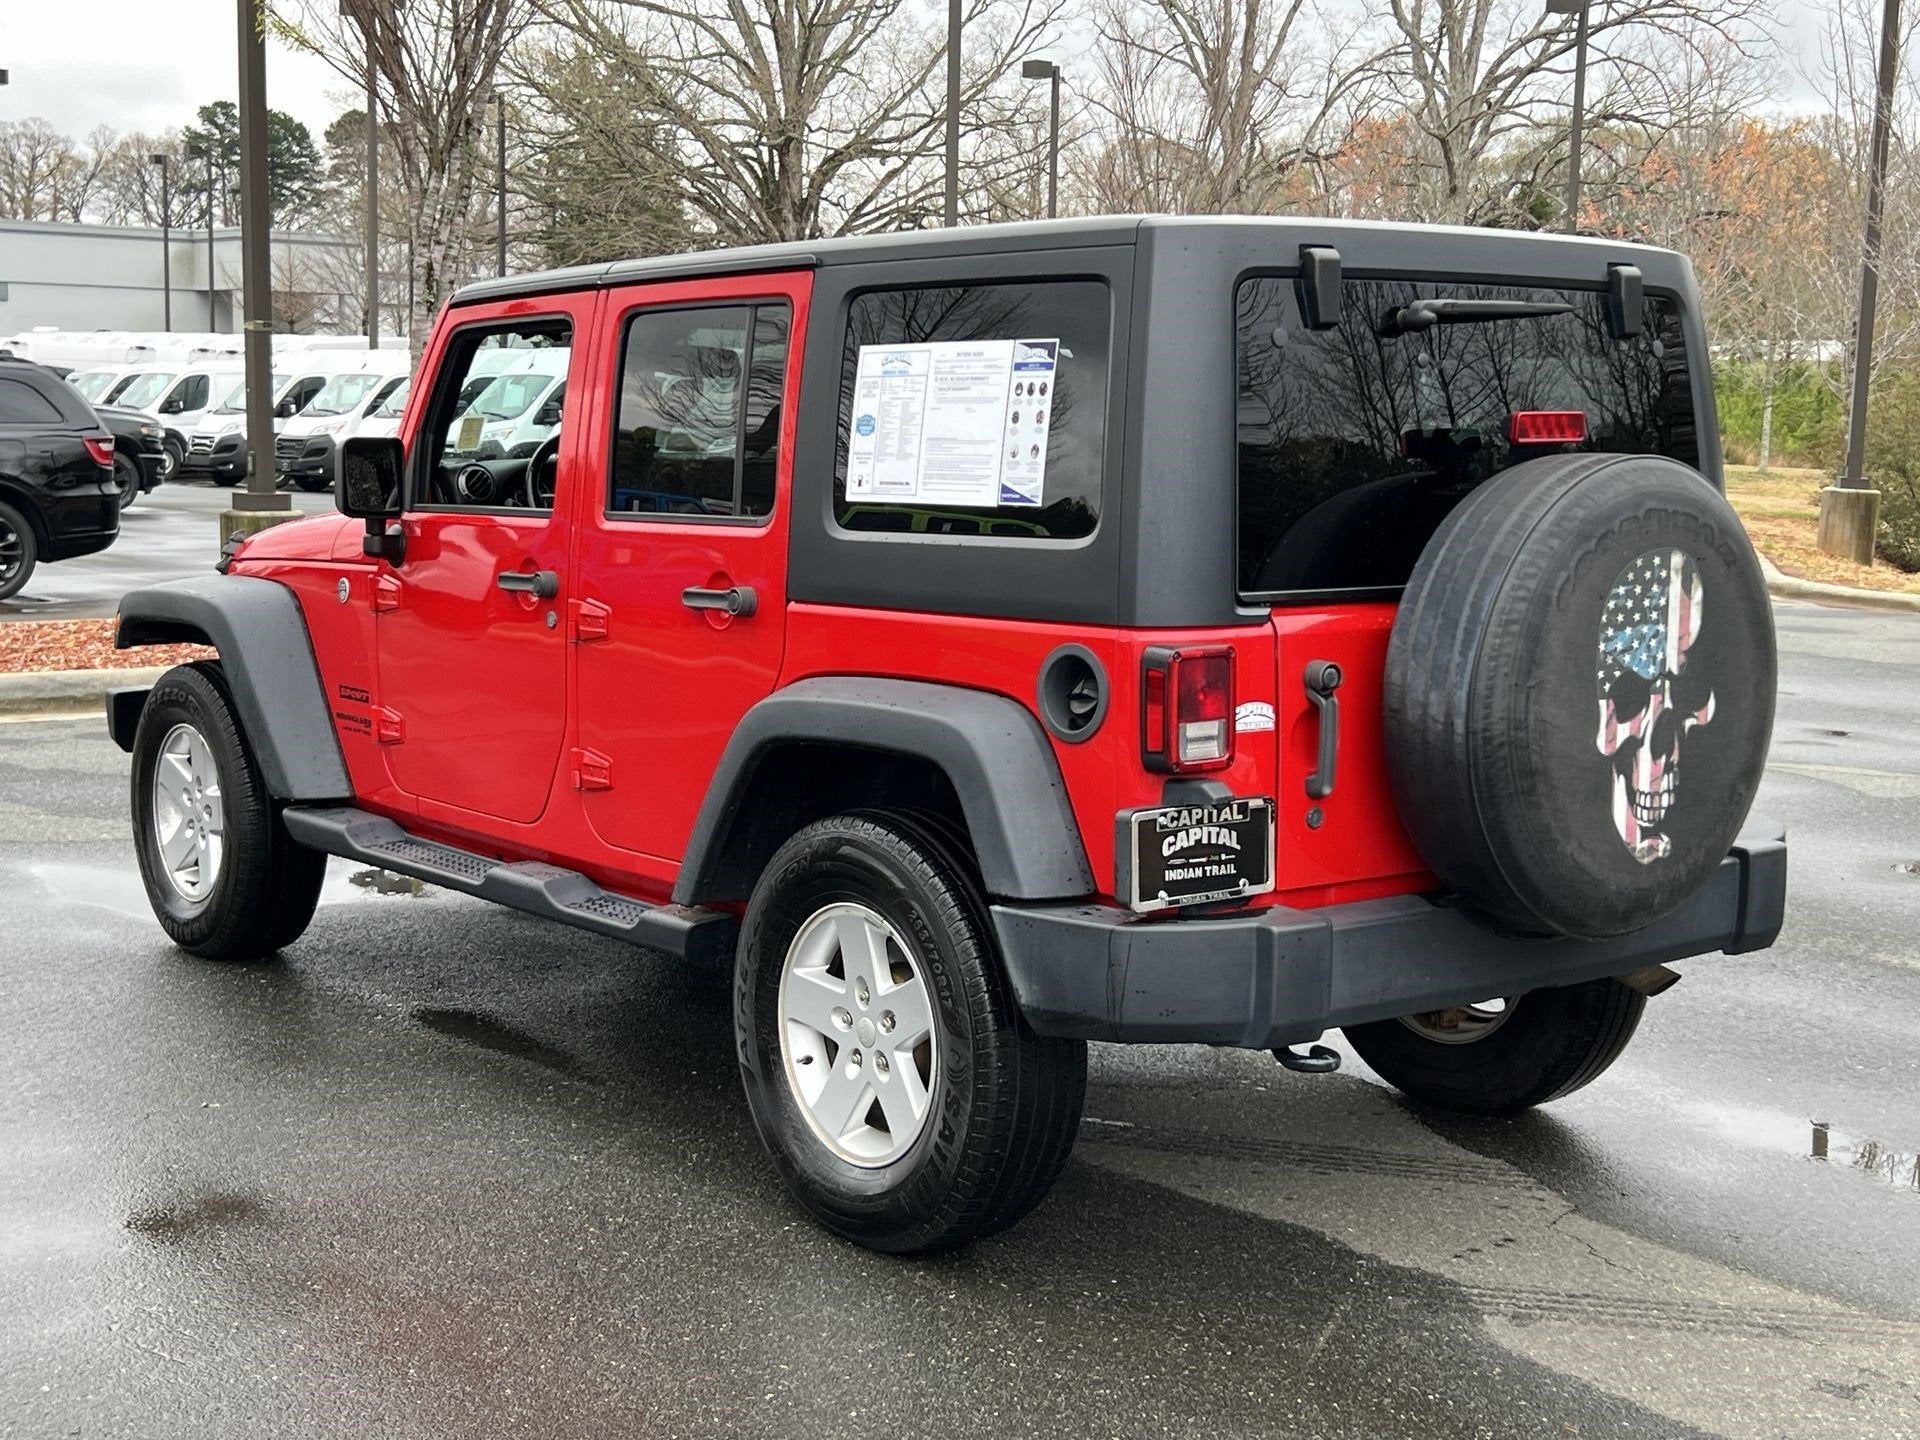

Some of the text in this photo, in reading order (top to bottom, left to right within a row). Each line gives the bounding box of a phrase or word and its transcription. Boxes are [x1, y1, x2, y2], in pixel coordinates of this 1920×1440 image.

[341, 687, 368, 701] SPORT
[1166, 803, 1243, 828] CAPITAL
[1162, 826, 1242, 857] CAPITAL
[1164, 863, 1237, 882] INDIAN TRAIL
[1180, 890, 1232, 905] INDIAN TRAIL
